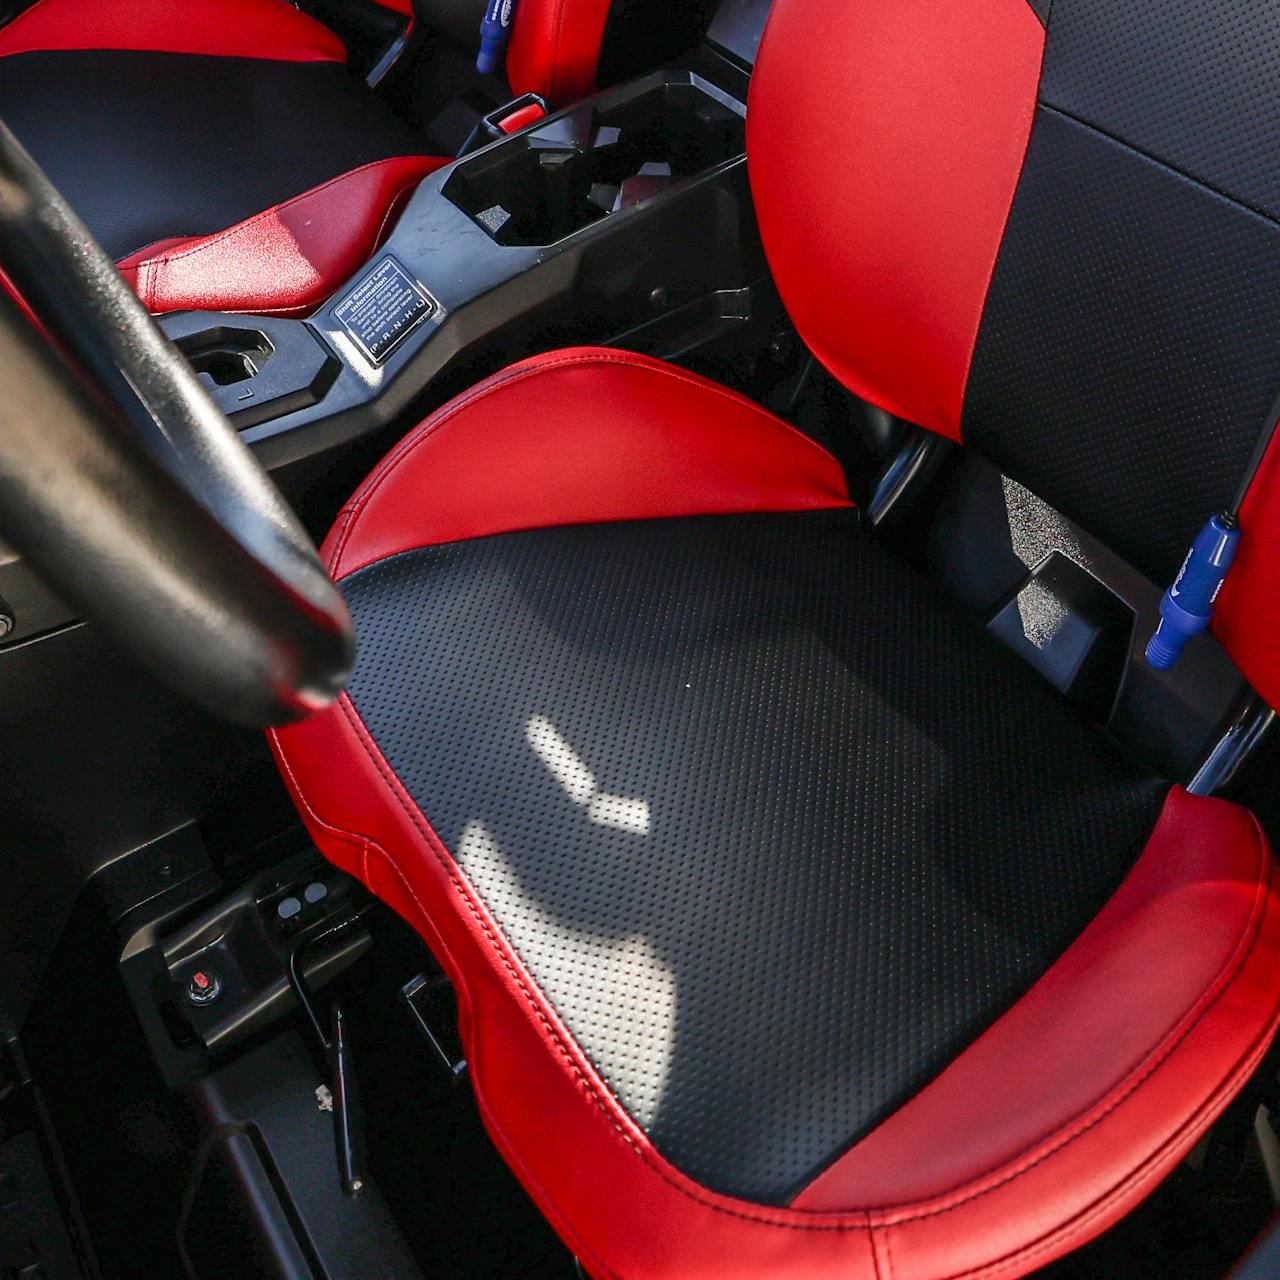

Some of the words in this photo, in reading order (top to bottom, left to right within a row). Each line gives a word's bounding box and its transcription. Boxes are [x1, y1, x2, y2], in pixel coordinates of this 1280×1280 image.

[337, 300, 354, 316] Shift
[353, 281, 373, 301] Select
[374, 263, 392, 281] Lever
[351, 276, 388, 312] Information
[358, 299, 377, 318] prevent
[376, 278, 399, 300] drivetrain
[378, 293, 391, 306] bring
[381, 289, 403, 310] complete
[372, 311, 389, 327] before
[388, 289, 412, 312] operating
[386, 307, 401, 321] select
[401, 295, 414, 307] lever
